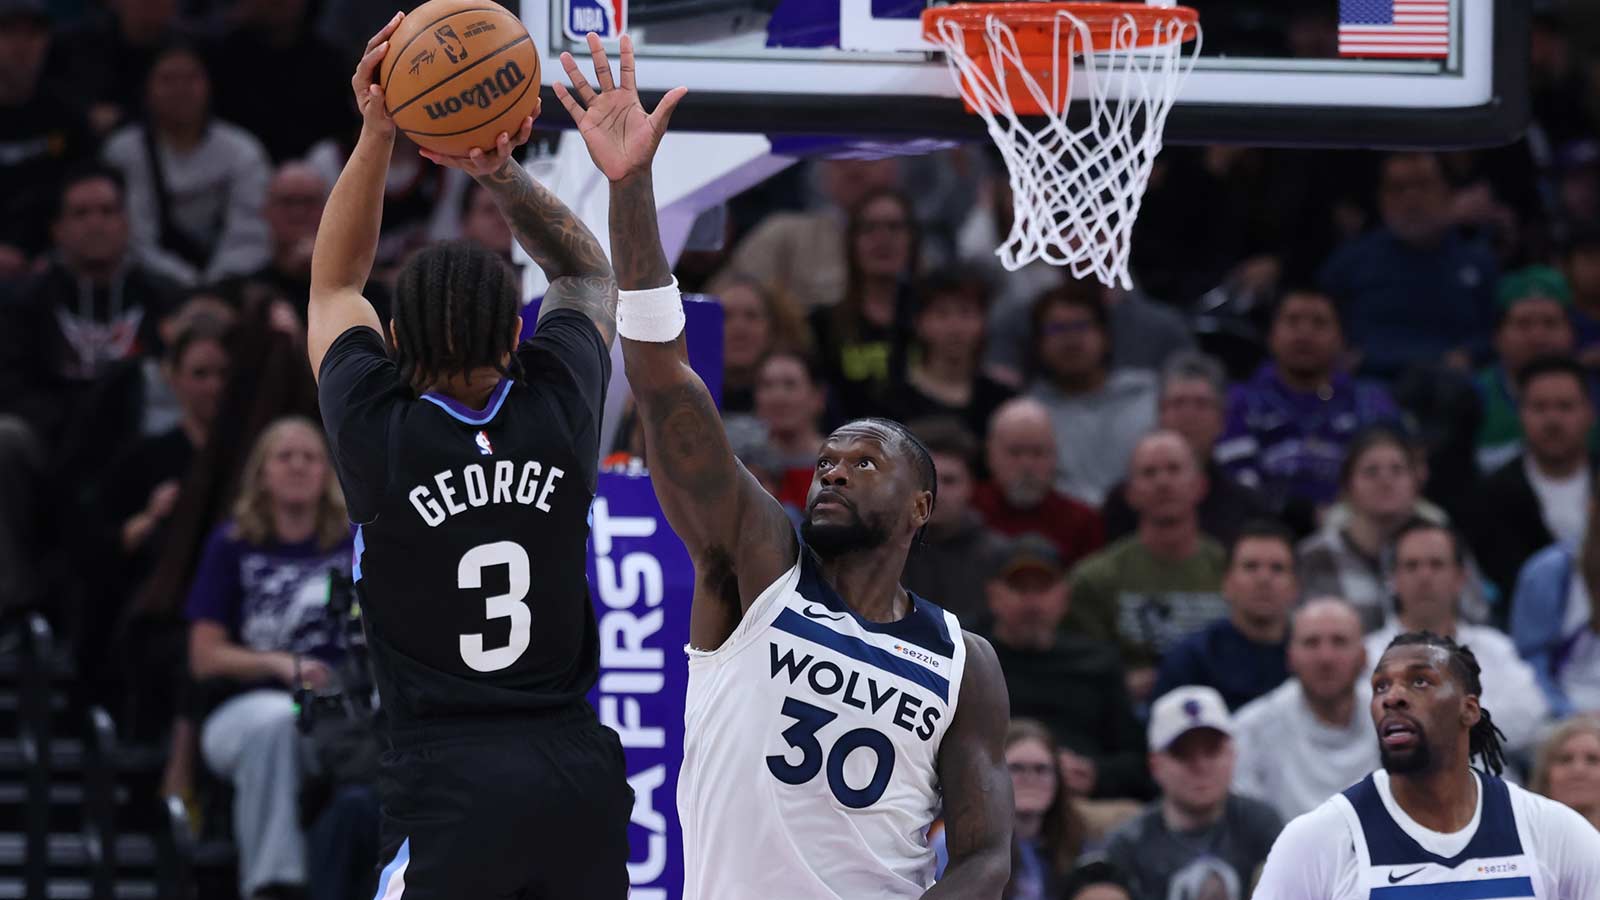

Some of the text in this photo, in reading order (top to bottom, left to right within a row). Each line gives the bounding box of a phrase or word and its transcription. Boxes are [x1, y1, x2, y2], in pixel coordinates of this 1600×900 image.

[573, 7, 604, 32] NBA
[424, 60, 526, 120] Wilson
[409, 460, 565, 527] GEORGE
[457, 540, 532, 672] 3
[593, 496, 666, 749] FIRST
[902, 646, 940, 668] sezzle
[769, 641, 941, 742] WOLVES
[766, 696, 896, 809] 30
[1484, 863, 1518, 874] sezzle
